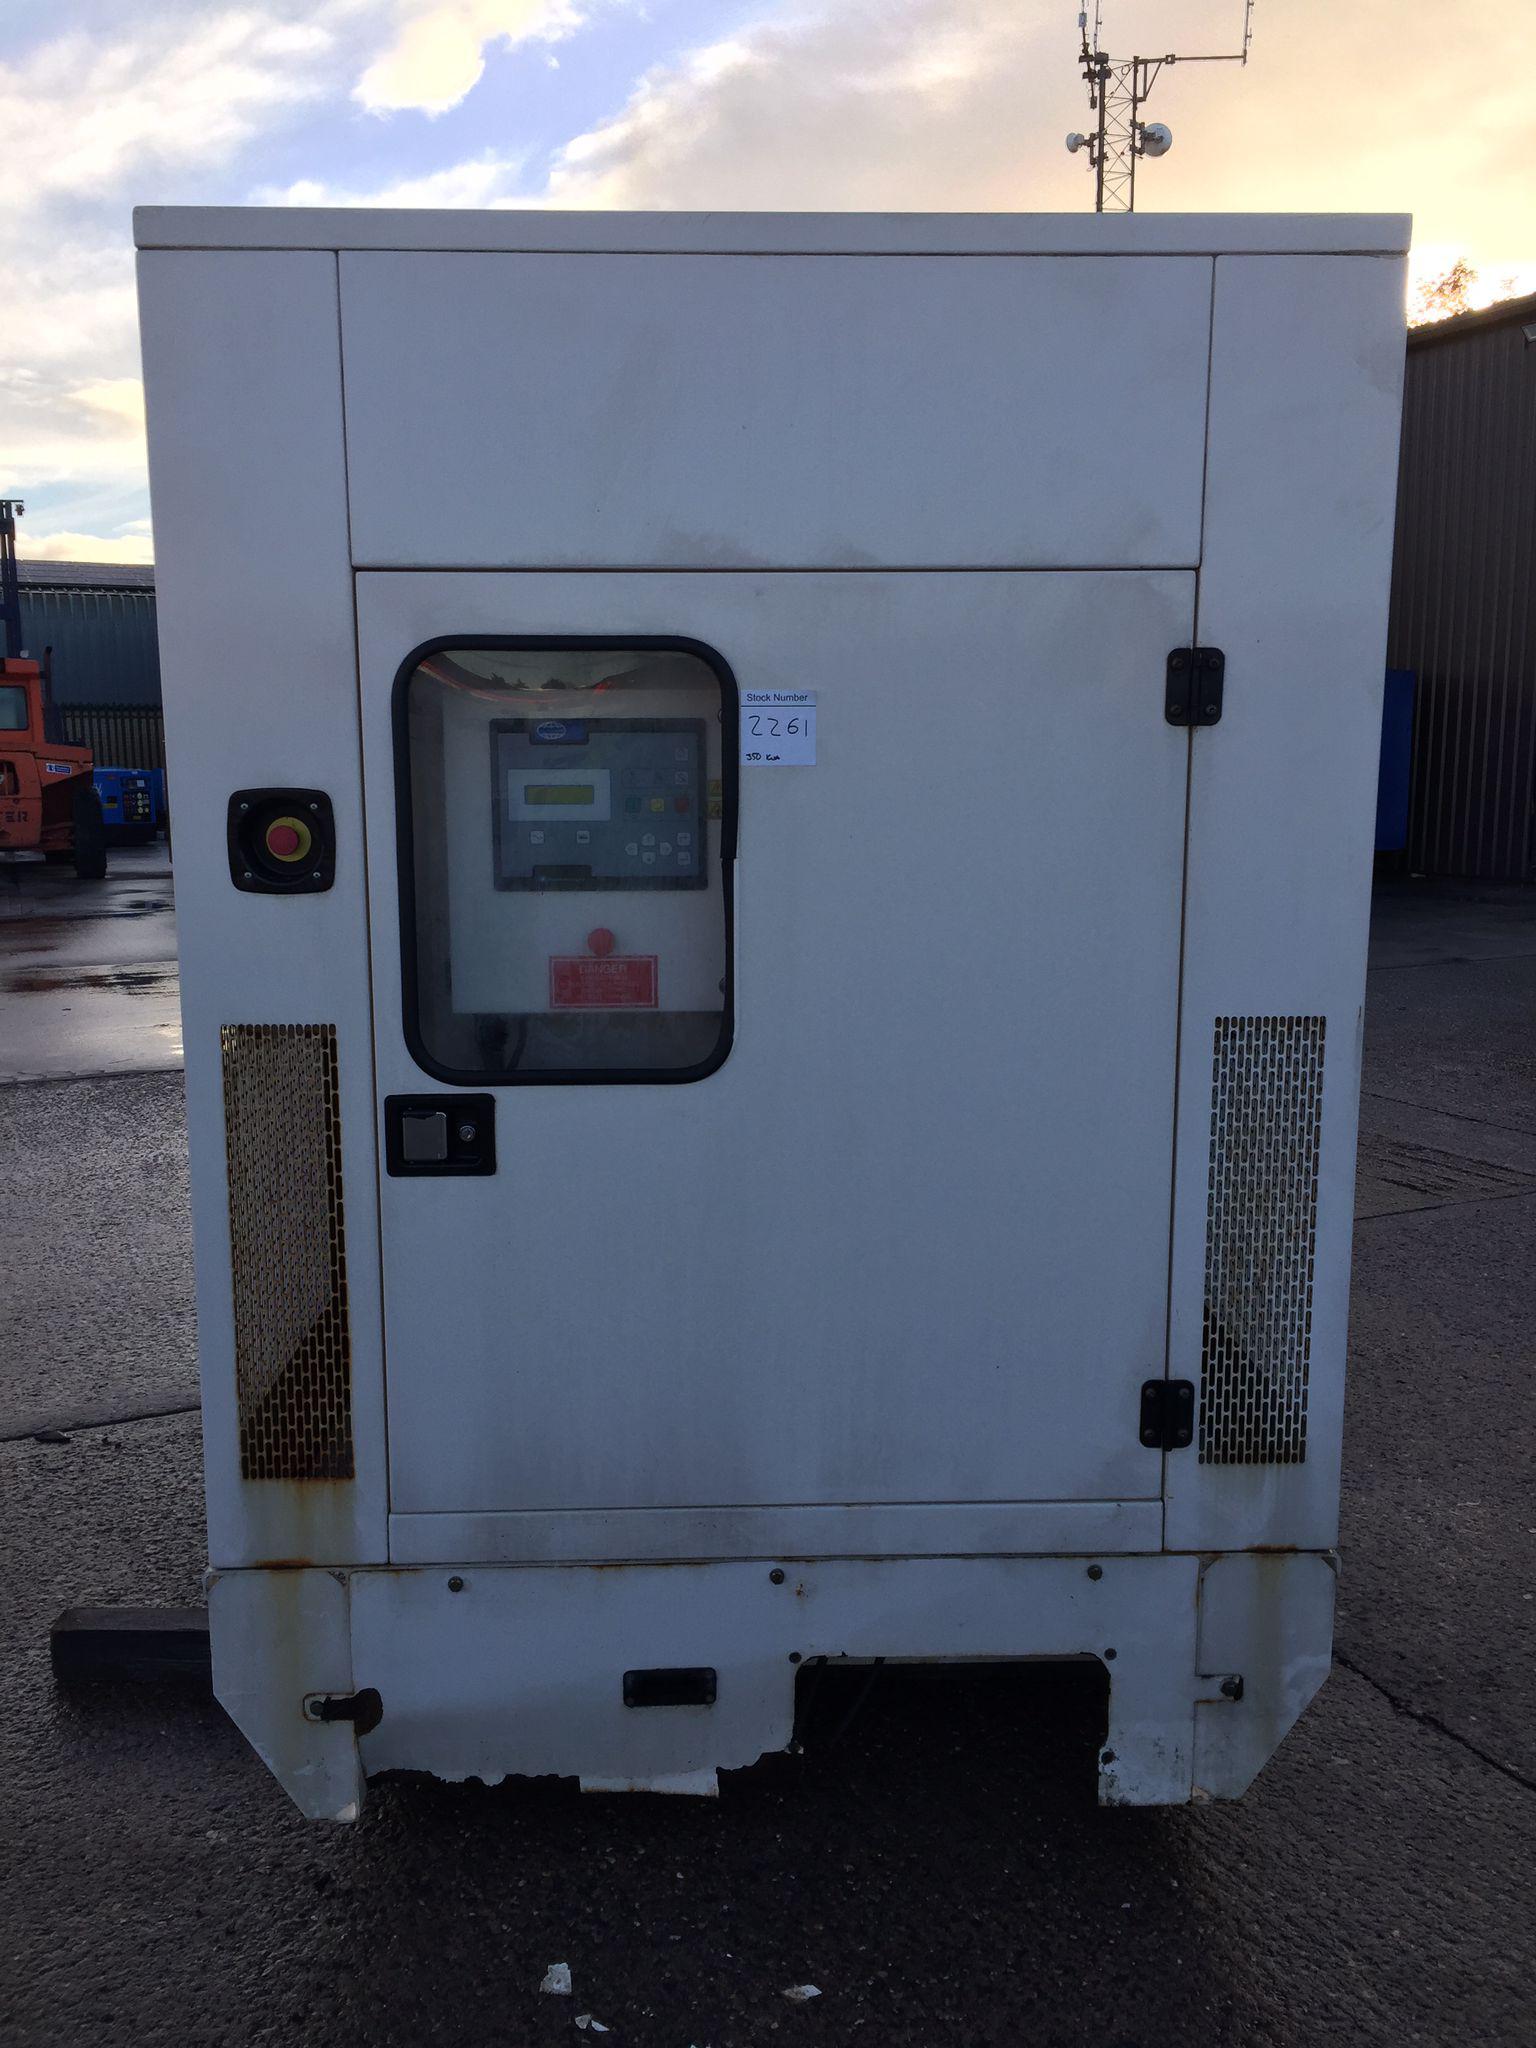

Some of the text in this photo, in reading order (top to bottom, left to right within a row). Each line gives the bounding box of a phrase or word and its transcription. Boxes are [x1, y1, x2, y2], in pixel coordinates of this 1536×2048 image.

[746, 693, 808, 702] Stock Number
[748, 715, 808, 737] 2261
[745, 752, 762, 761] 350
[578, 963, 627, 976] DANGER
